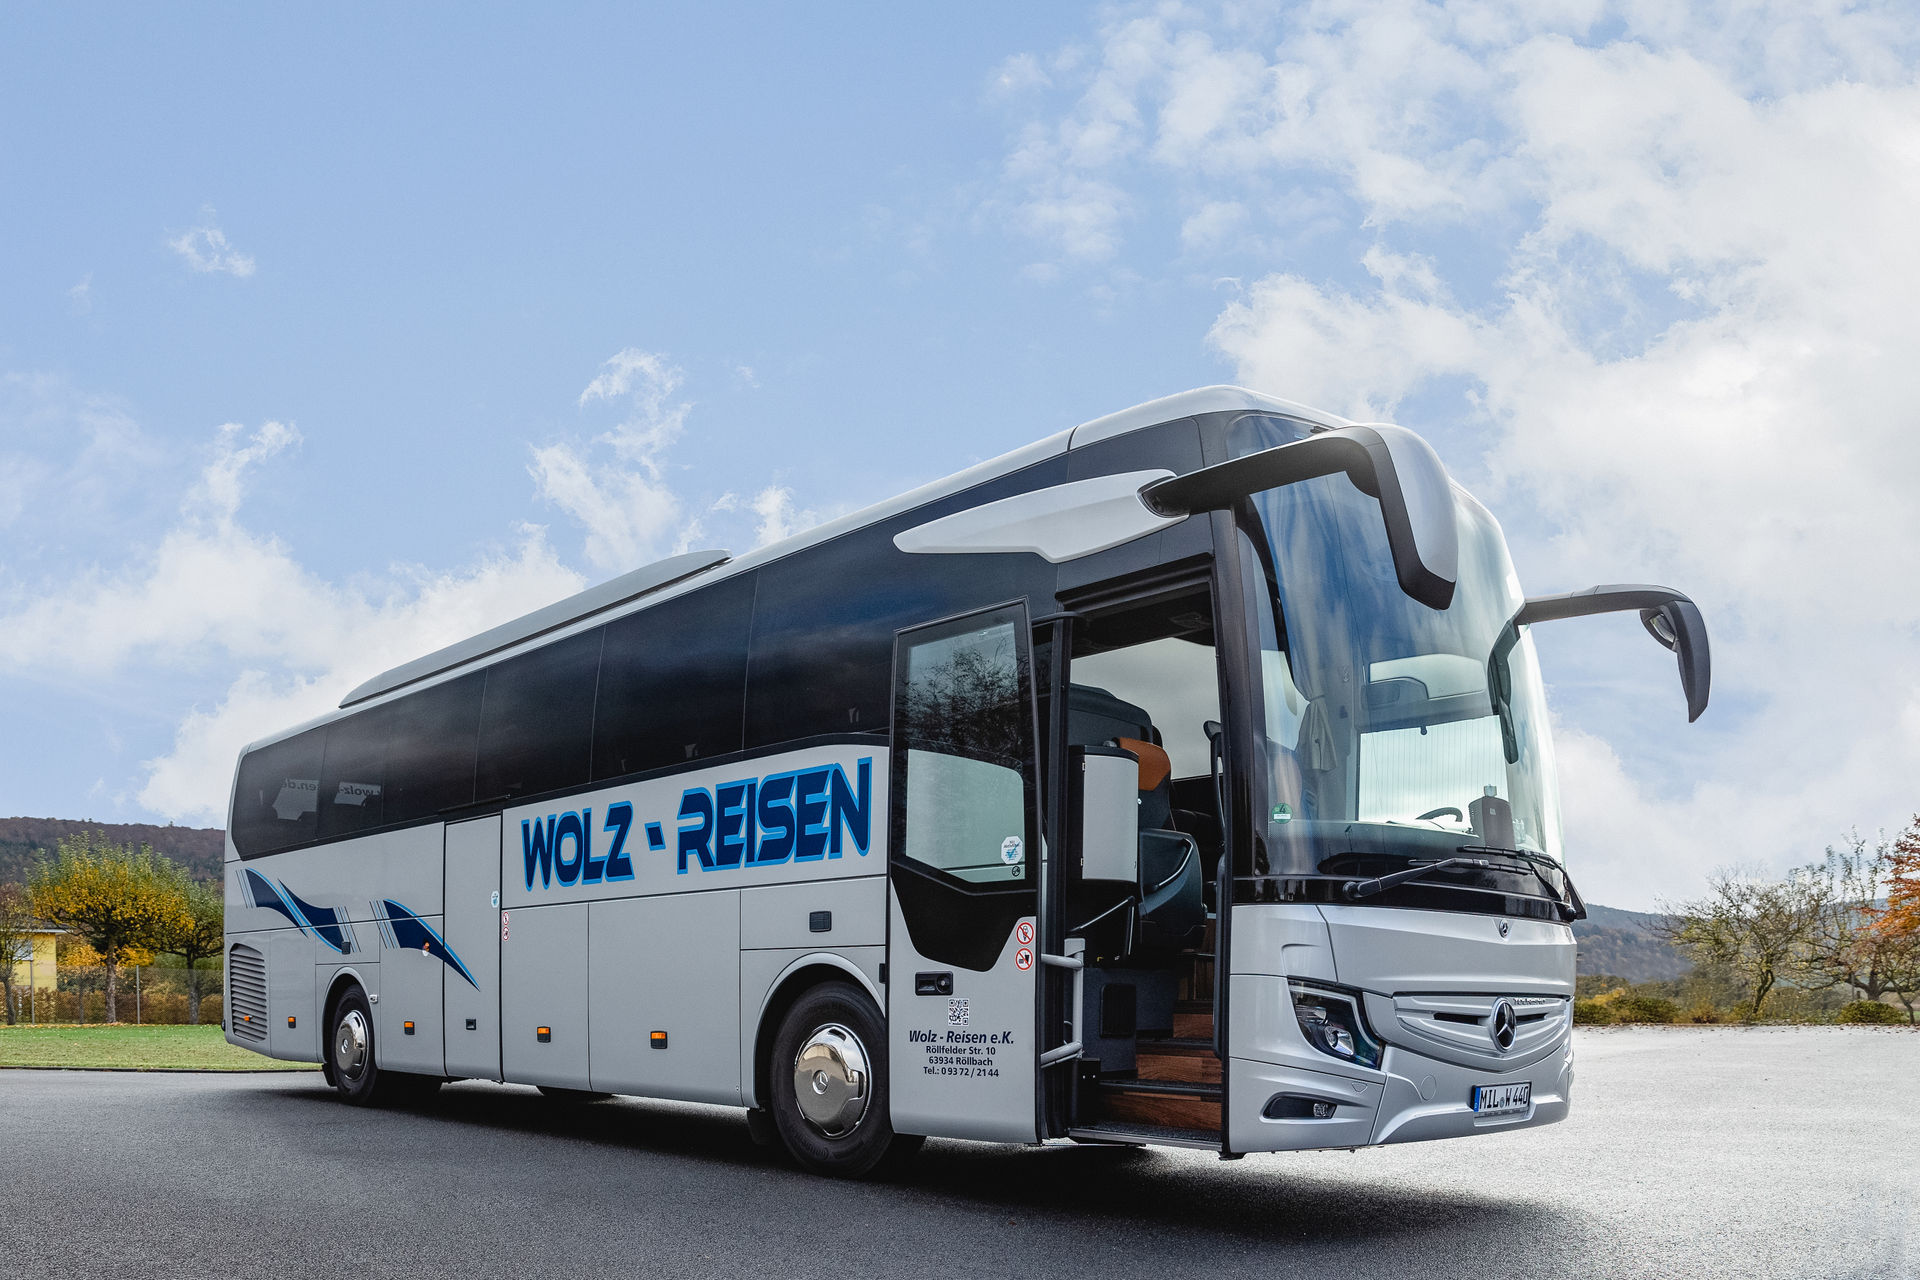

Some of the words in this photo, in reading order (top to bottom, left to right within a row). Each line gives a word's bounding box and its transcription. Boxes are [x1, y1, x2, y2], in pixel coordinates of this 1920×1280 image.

[1280, 804, 1287, 815] 4
[521, 800, 635, 892] WOLZ
[677, 757, 872, 874] REISEN
[909, 1030, 937, 1042] Wolz
[947, 1031, 987, 1043] Reisen
[991, 1031, 1014, 1044] e.K.
[926, 1046, 966, 1054] Röllfelder
[969, 1047, 983, 1055] Str.
[986, 1047, 995, 1055] 10
[929, 1056, 954, 1064] 63934
[956, 1057, 993, 1066] Röllbach
[1480, 1089, 1498, 1109] MIL
[1513, 1086, 1529, 1105] 440
